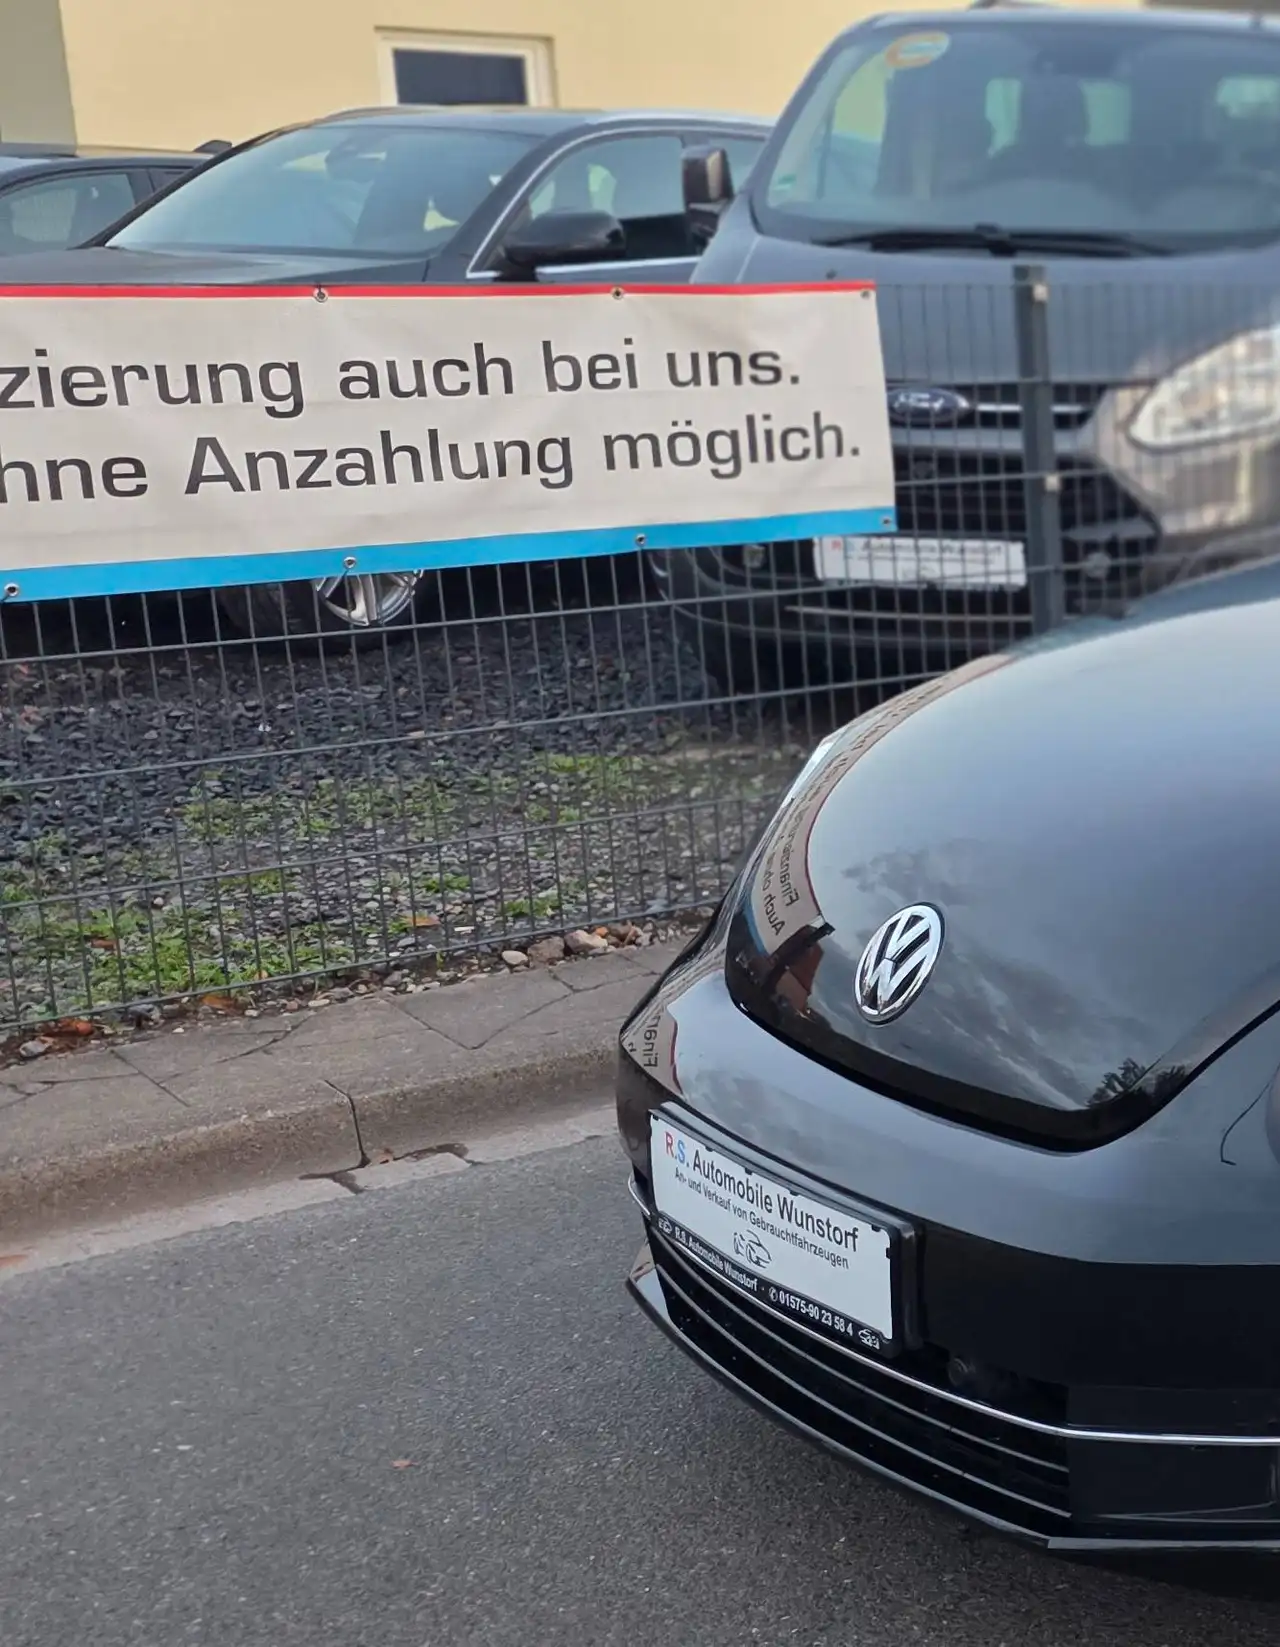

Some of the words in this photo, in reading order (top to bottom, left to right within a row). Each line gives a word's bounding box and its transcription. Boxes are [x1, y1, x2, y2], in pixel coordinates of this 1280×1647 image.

[0, 348, 304, 419] zierung
[339, 342, 515, 399] auch
[542, 337, 639, 393] bei
[666, 349, 800, 388] uns.
[184, 428, 573, 495] Anzahlung
[603, 410, 860, 480] möglich.
[855, 903, 943, 1023] VW
[664, 1131, 690, 1168] R.S.
[692, 1149, 774, 1214] Automobile
[777, 1193, 859, 1252] Wunstorf
[687, 1178, 702, 1194] und
[702, 1182, 732, 1212] Verkauf
[732, 1205, 749, 1222] von
[749, 1211, 849, 1270] Gebrauchtfahrzeugen
[723, 1259, 758, 1292] Wunstorf
[821, 1309, 833, 1327] 23
[834, 1315, 846, 1333] 58
[846, 1322, 854, 1337] 4
